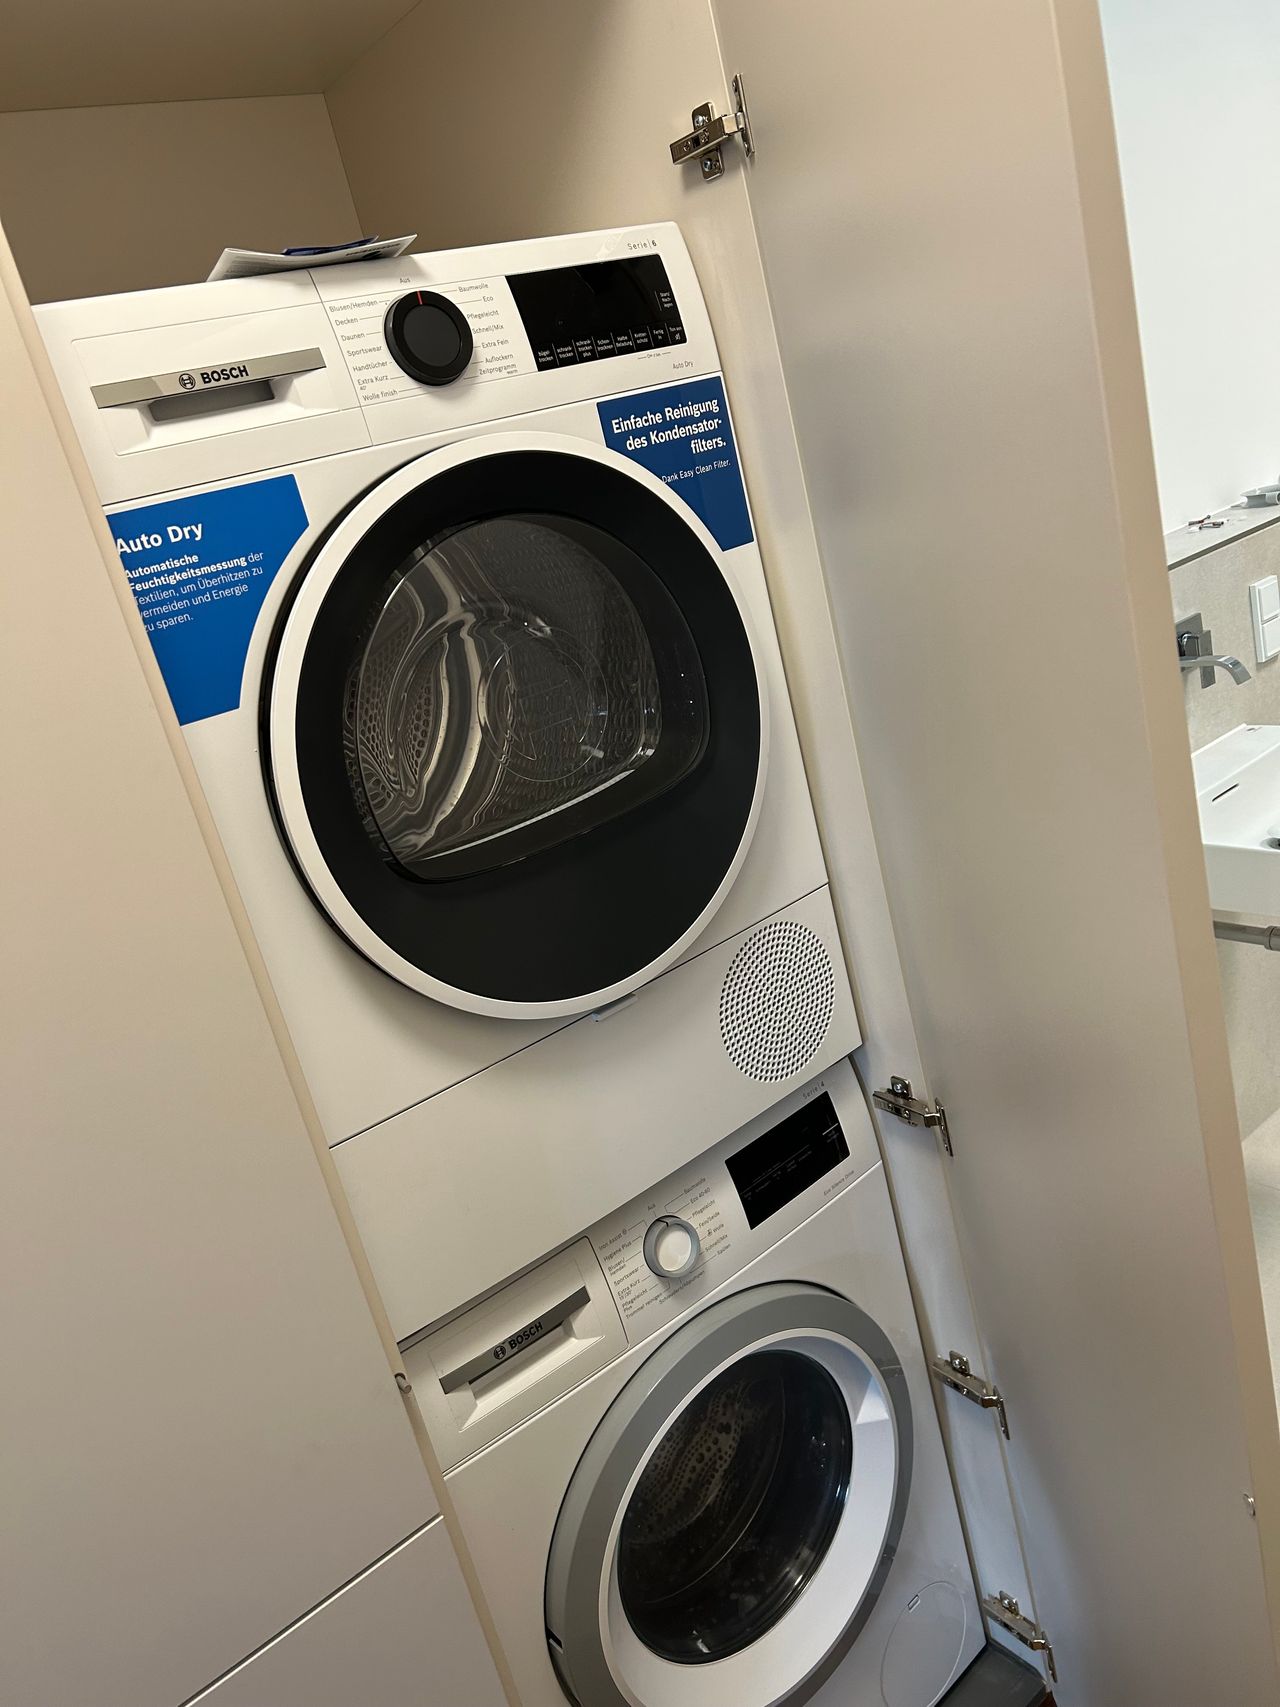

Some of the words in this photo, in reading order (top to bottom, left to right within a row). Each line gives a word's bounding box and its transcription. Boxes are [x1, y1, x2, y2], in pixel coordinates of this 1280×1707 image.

[627, 241, 648, 250] Serie
[458, 283, 489, 292] Baumwolle
[482, 295, 494, 303] Eco
[328, 300, 378, 313] Blusen/Hemden
[466, 310, 500, 320] Pflegeleicht
[334, 317, 359, 326] Decken
[472, 324, 505, 334] Schnell/Mix
[340, 332, 366, 342] Daunen
[481, 341, 497, 349] Extra
[497, 338, 510, 346] Fein
[346, 345, 382, 357] Sportswear
[485, 353, 514, 363] Auflockern
[684, 360, 694, 368] Dry
[352, 361, 388, 372] Handtücher
[479, 363, 517, 376] Zeitprogramm
[200, 364, 250, 385] BOSCH
[357, 377, 374, 386] Extra
[374, 375, 389, 383] Kurz
[362, 392, 381, 401] Wolle
[380, 389, 398, 398] finish
[611, 411, 663, 434] Einfache
[664, 399, 720, 422] Reinigung
[626, 435, 648, 451] des
[649, 418, 722, 445] Kondensator-
[690, 436, 727, 455] filters.
[661, 472, 679, 483] Dank
[679, 468, 694, 479] Easy
[695, 464, 713, 475] Clean
[713, 459, 731, 470] Filter.
[115, 533, 163, 555] Auto
[166, 522, 203, 543] Dry
[248, 552, 264, 564] der
[124, 554, 199, 579] Automatische
[181, 583, 197, 595] um
[198, 569, 250, 590] Überhitzen
[251, 565, 264, 576] zu
[192, 592, 212, 606] und
[214, 583, 249, 601] Energie
[156, 613, 194, 630] sparen.
[617, 1286, 630, 1297] Extra
[630, 1278, 641, 1289] Kurz
[508, 1321, 544, 1351] BOSCH
